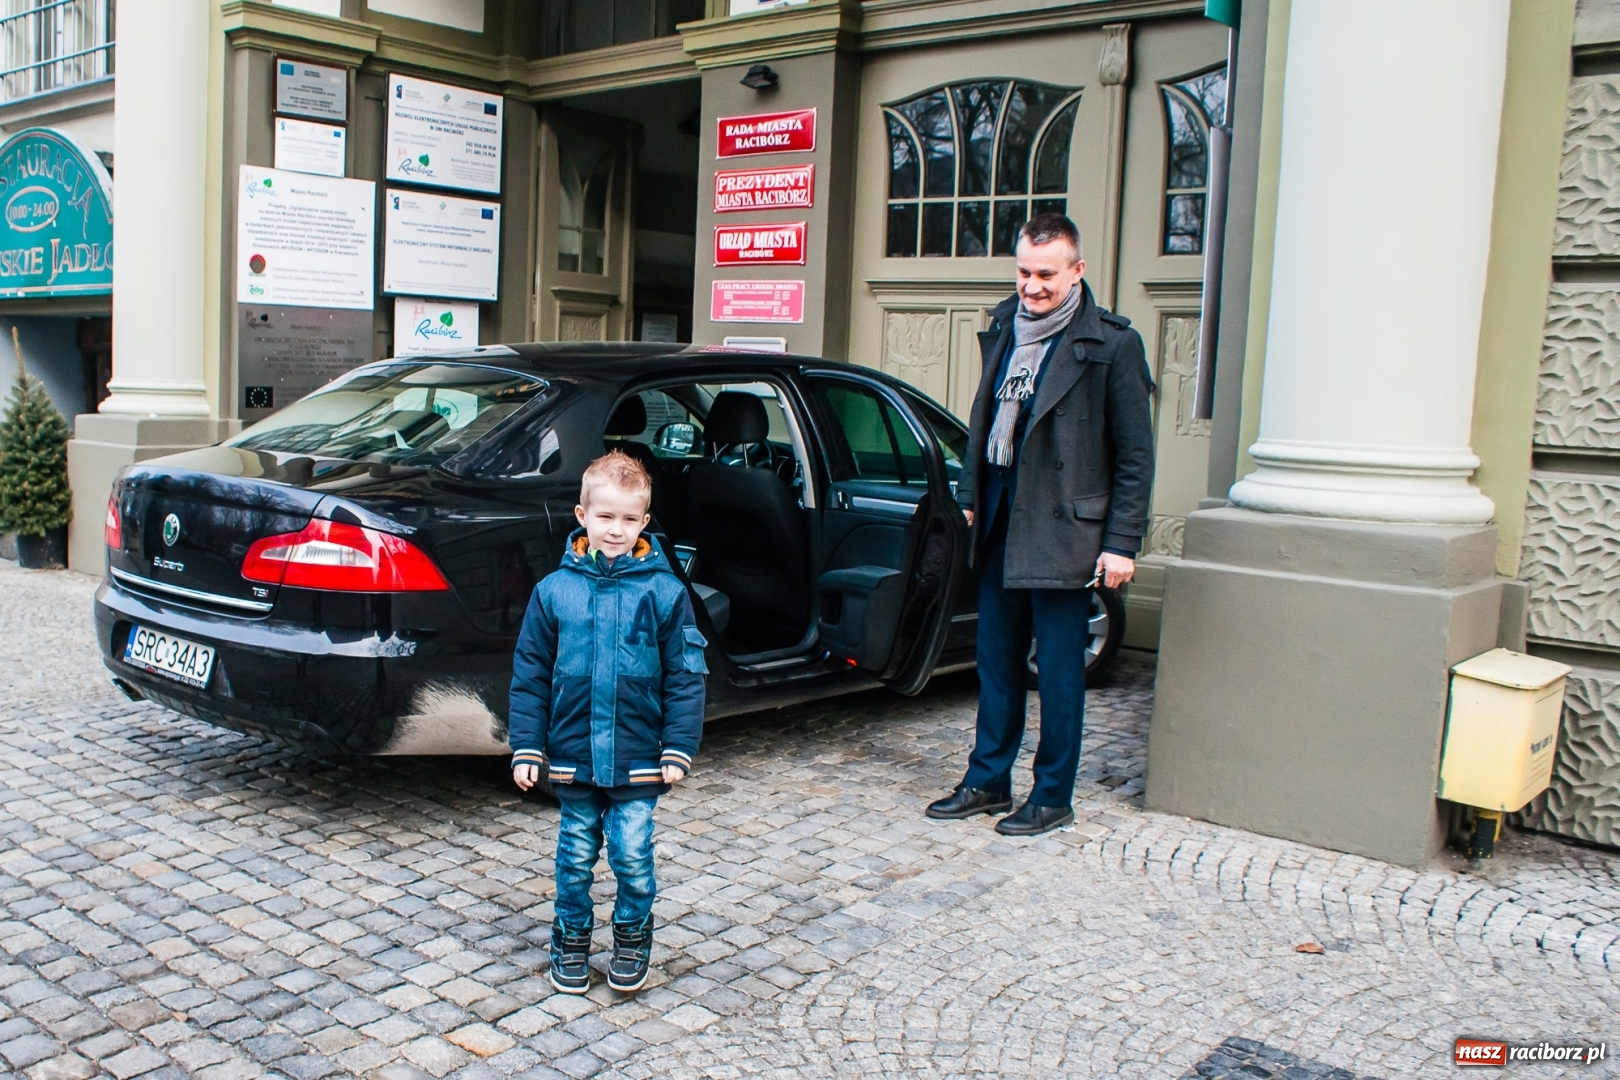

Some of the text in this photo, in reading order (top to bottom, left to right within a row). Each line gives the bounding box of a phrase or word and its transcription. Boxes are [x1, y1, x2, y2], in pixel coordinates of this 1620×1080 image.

[726, 119, 803, 136] RADA MIASTA
[735, 133, 790, 149] RACIBÓRZ
[718, 172, 808, 192] PREZYDENT
[718, 186, 807, 207] MIASTA RACIBÓRZ
[719, 230, 798, 251] URZĄD MIASTA
[0, 247, 44, 277] SKIE
[738, 248, 774, 258] RACIBÓRZ
[414, 318, 462, 340] Racibórz
[153, 556, 184, 572] Superb
[624, 594, 656, 648] A
[134, 630, 210, 678] SRC 34A3
